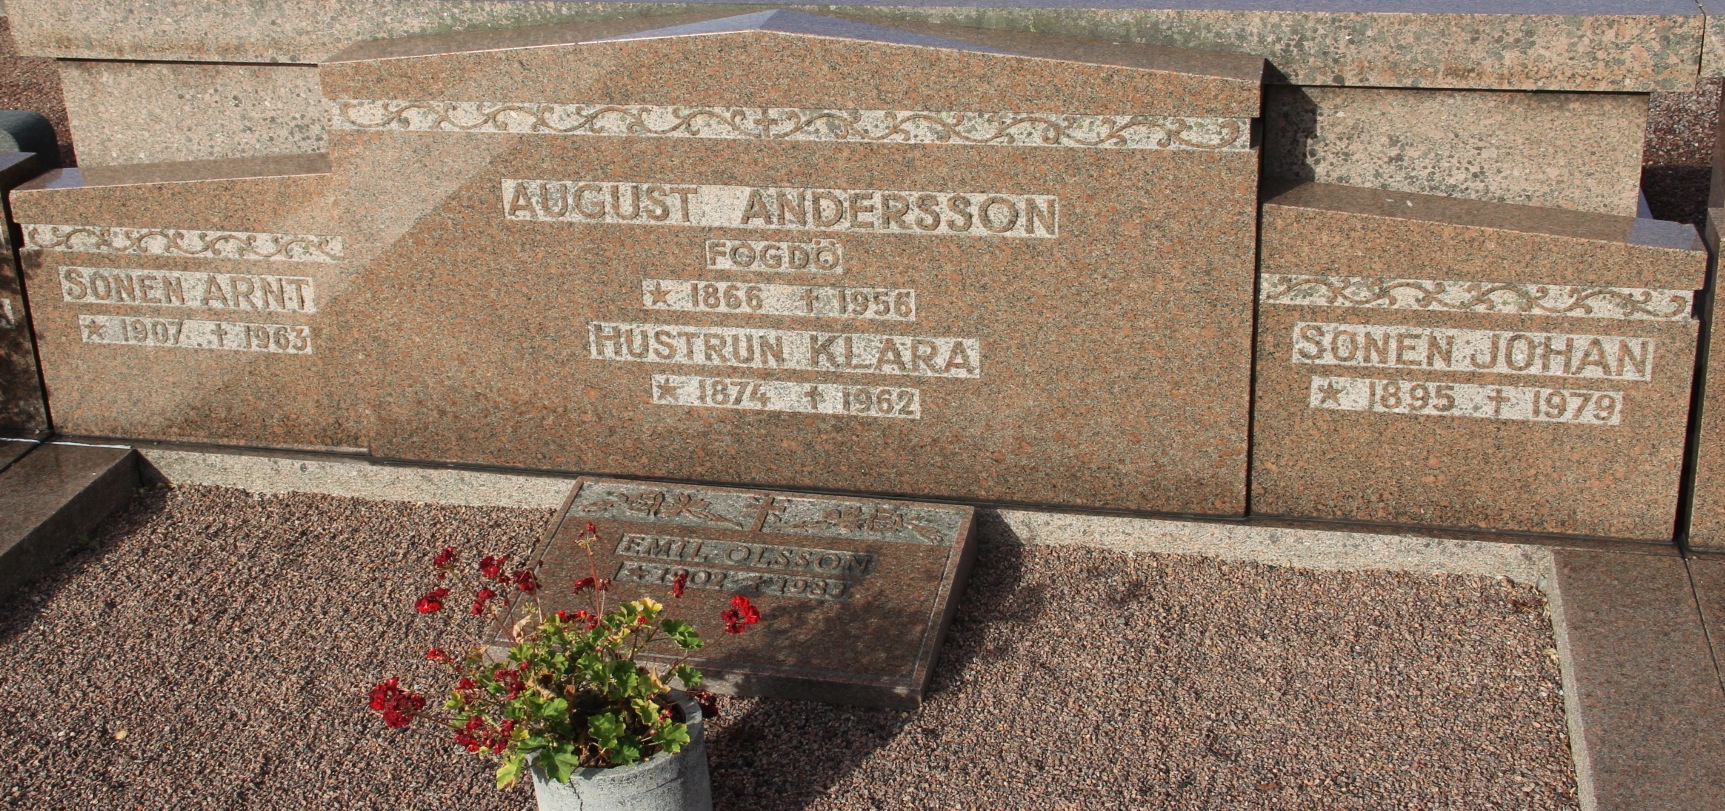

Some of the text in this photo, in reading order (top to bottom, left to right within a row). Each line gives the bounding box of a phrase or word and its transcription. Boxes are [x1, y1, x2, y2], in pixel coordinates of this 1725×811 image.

[508, 181, 1056, 236] AUGUST ANDERSSON
[708, 238, 842, 271] FOGDÖ
[64, 268, 309, 311] SONEN ARNT
[690, 282, 913, 317] 1866 1956
[121, 318, 308, 351] 1907 1963
[595, 323, 972, 375] HUSTRUN KLARA
[1300, 324, 1649, 377] SONEN JOHAN
[699, 379, 916, 416] 1874 1962
[1369, 381, 1618, 421] 1895 1979
[623, 536, 871, 575] EMIL OLSSON
